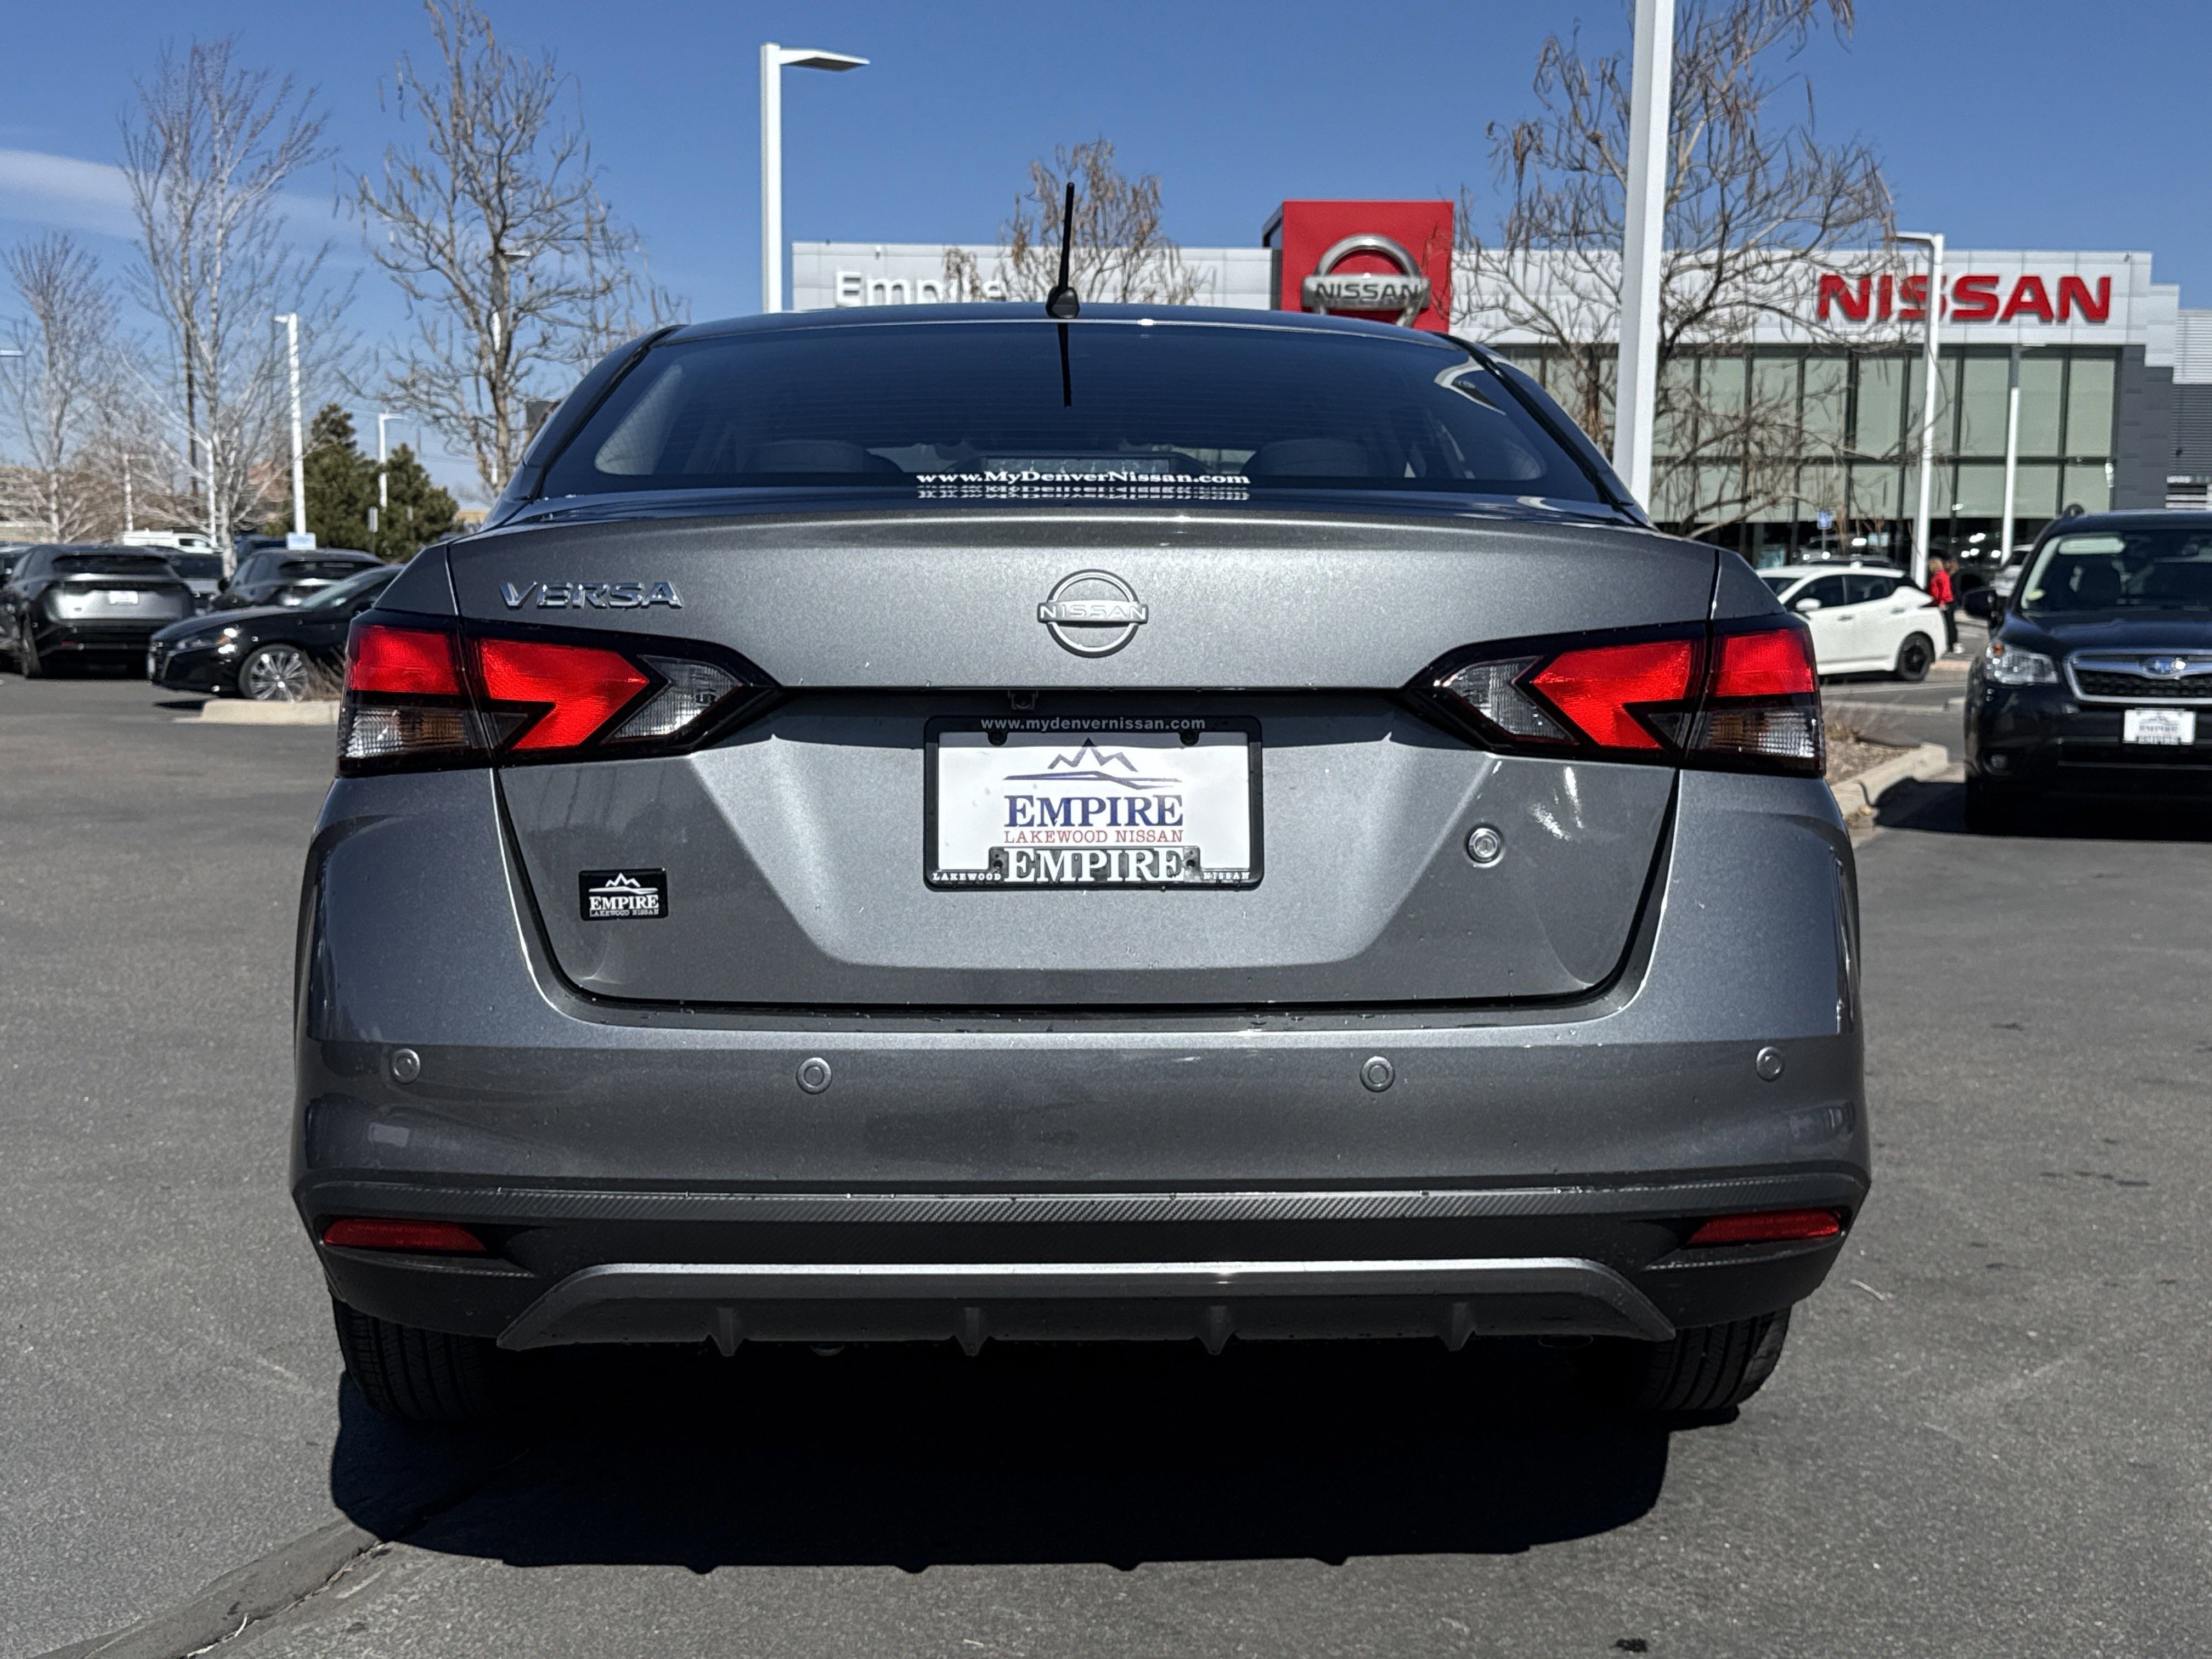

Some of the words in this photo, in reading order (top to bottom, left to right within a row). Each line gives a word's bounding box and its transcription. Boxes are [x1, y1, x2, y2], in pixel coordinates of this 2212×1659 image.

[1316, 283, 1419, 300] NISSAN
[1818, 274, 2111, 321] NISSAN
[917, 471, 1250, 485] www.MyDenverNissan.com
[499, 582, 683, 609] VERSA
[1040, 605, 1146, 620] NISSAN
[980, 718, 1206, 730] www.mydenvernissan.com
[1003, 794, 1184, 827] EMPIRE
[1005, 830, 1107, 843] LAKEWOOD
[1115, 829, 1184, 842] NISSAN
[933, 872, 1001, 881] LAKEWOOD
[1002, 848, 1185, 882] EMPIRE
[1203, 871, 1250, 879] NISSAN
[589, 895, 659, 910] EMPIRE
